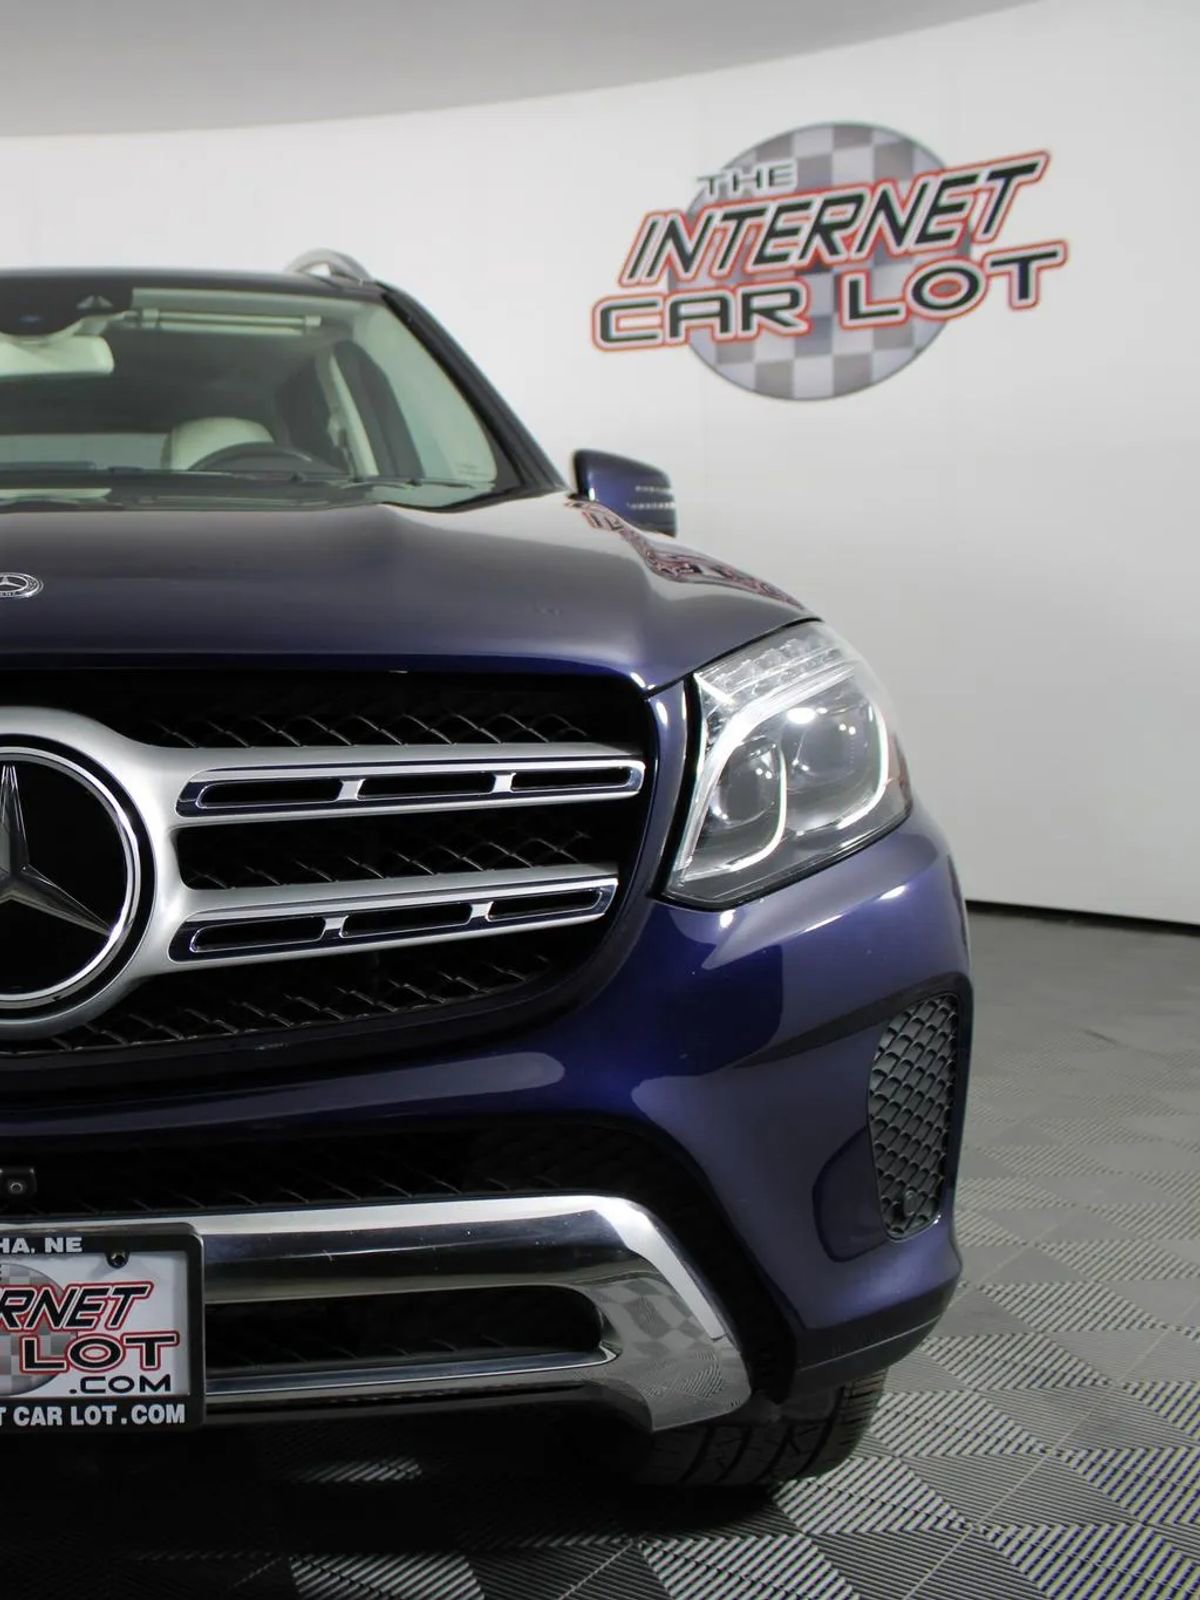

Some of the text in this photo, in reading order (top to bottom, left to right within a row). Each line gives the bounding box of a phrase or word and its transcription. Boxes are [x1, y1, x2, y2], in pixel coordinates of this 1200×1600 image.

[697, 161, 796, 197] THE
[624, 156, 1046, 283] INTERNET
[596, 246, 1063, 347] CAR LOT
[45, 1237, 83, 1253] NE
[22, 1333, 178, 1372] LOT
[69, 1375, 171, 1394] .COM
[13, 1406, 62, 1426] CAR
